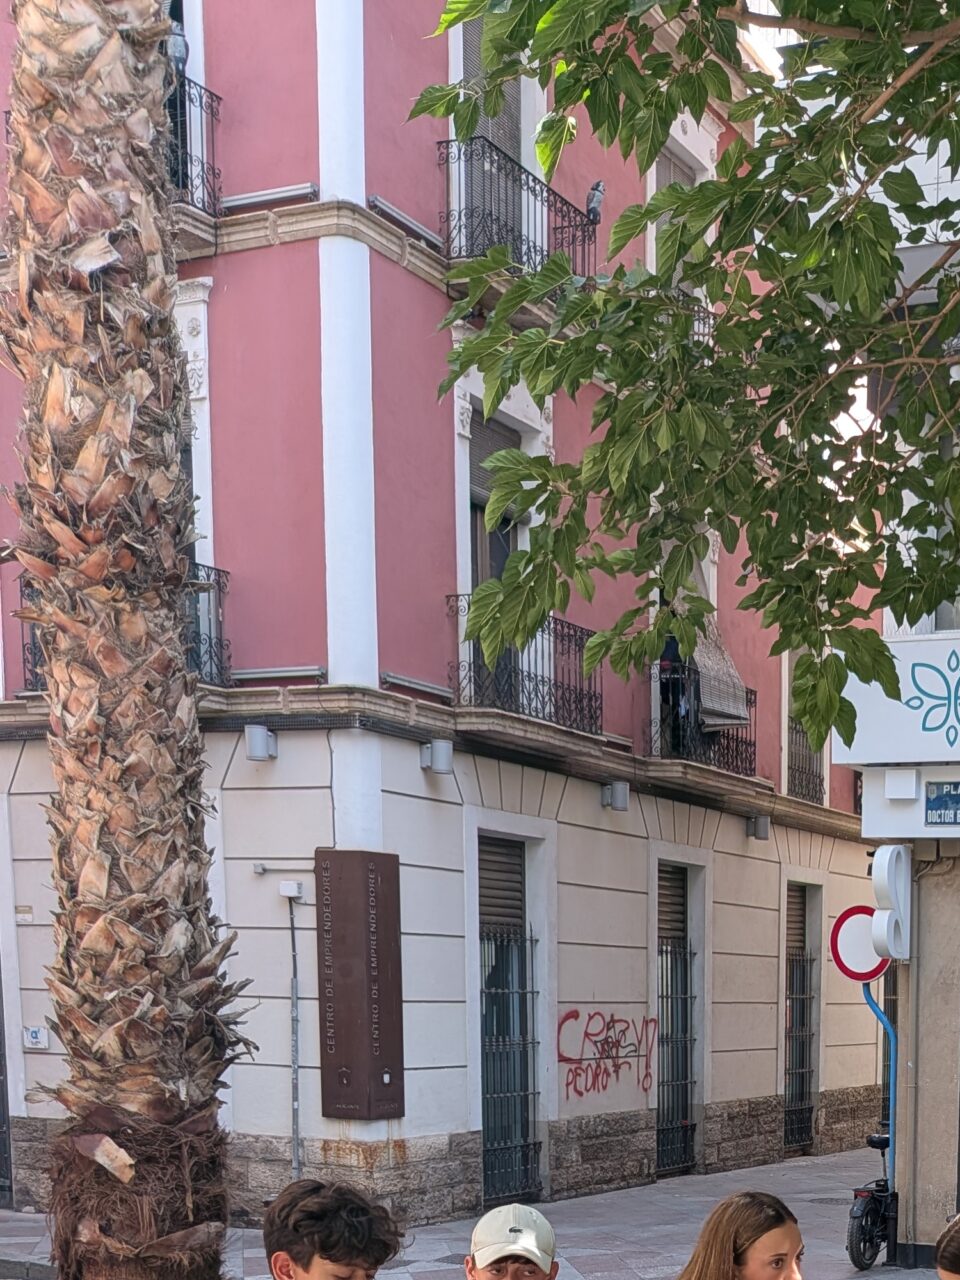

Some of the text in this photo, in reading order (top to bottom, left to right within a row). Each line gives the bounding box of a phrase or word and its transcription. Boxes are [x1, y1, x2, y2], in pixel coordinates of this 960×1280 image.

[927, 810, 955, 823] DOCTOR
[321, 859, 335, 1054] CENTRO DE EMPRENDEDORES
[368, 861, 380, 1056] CENTRO DE EMPRENDEDORES
